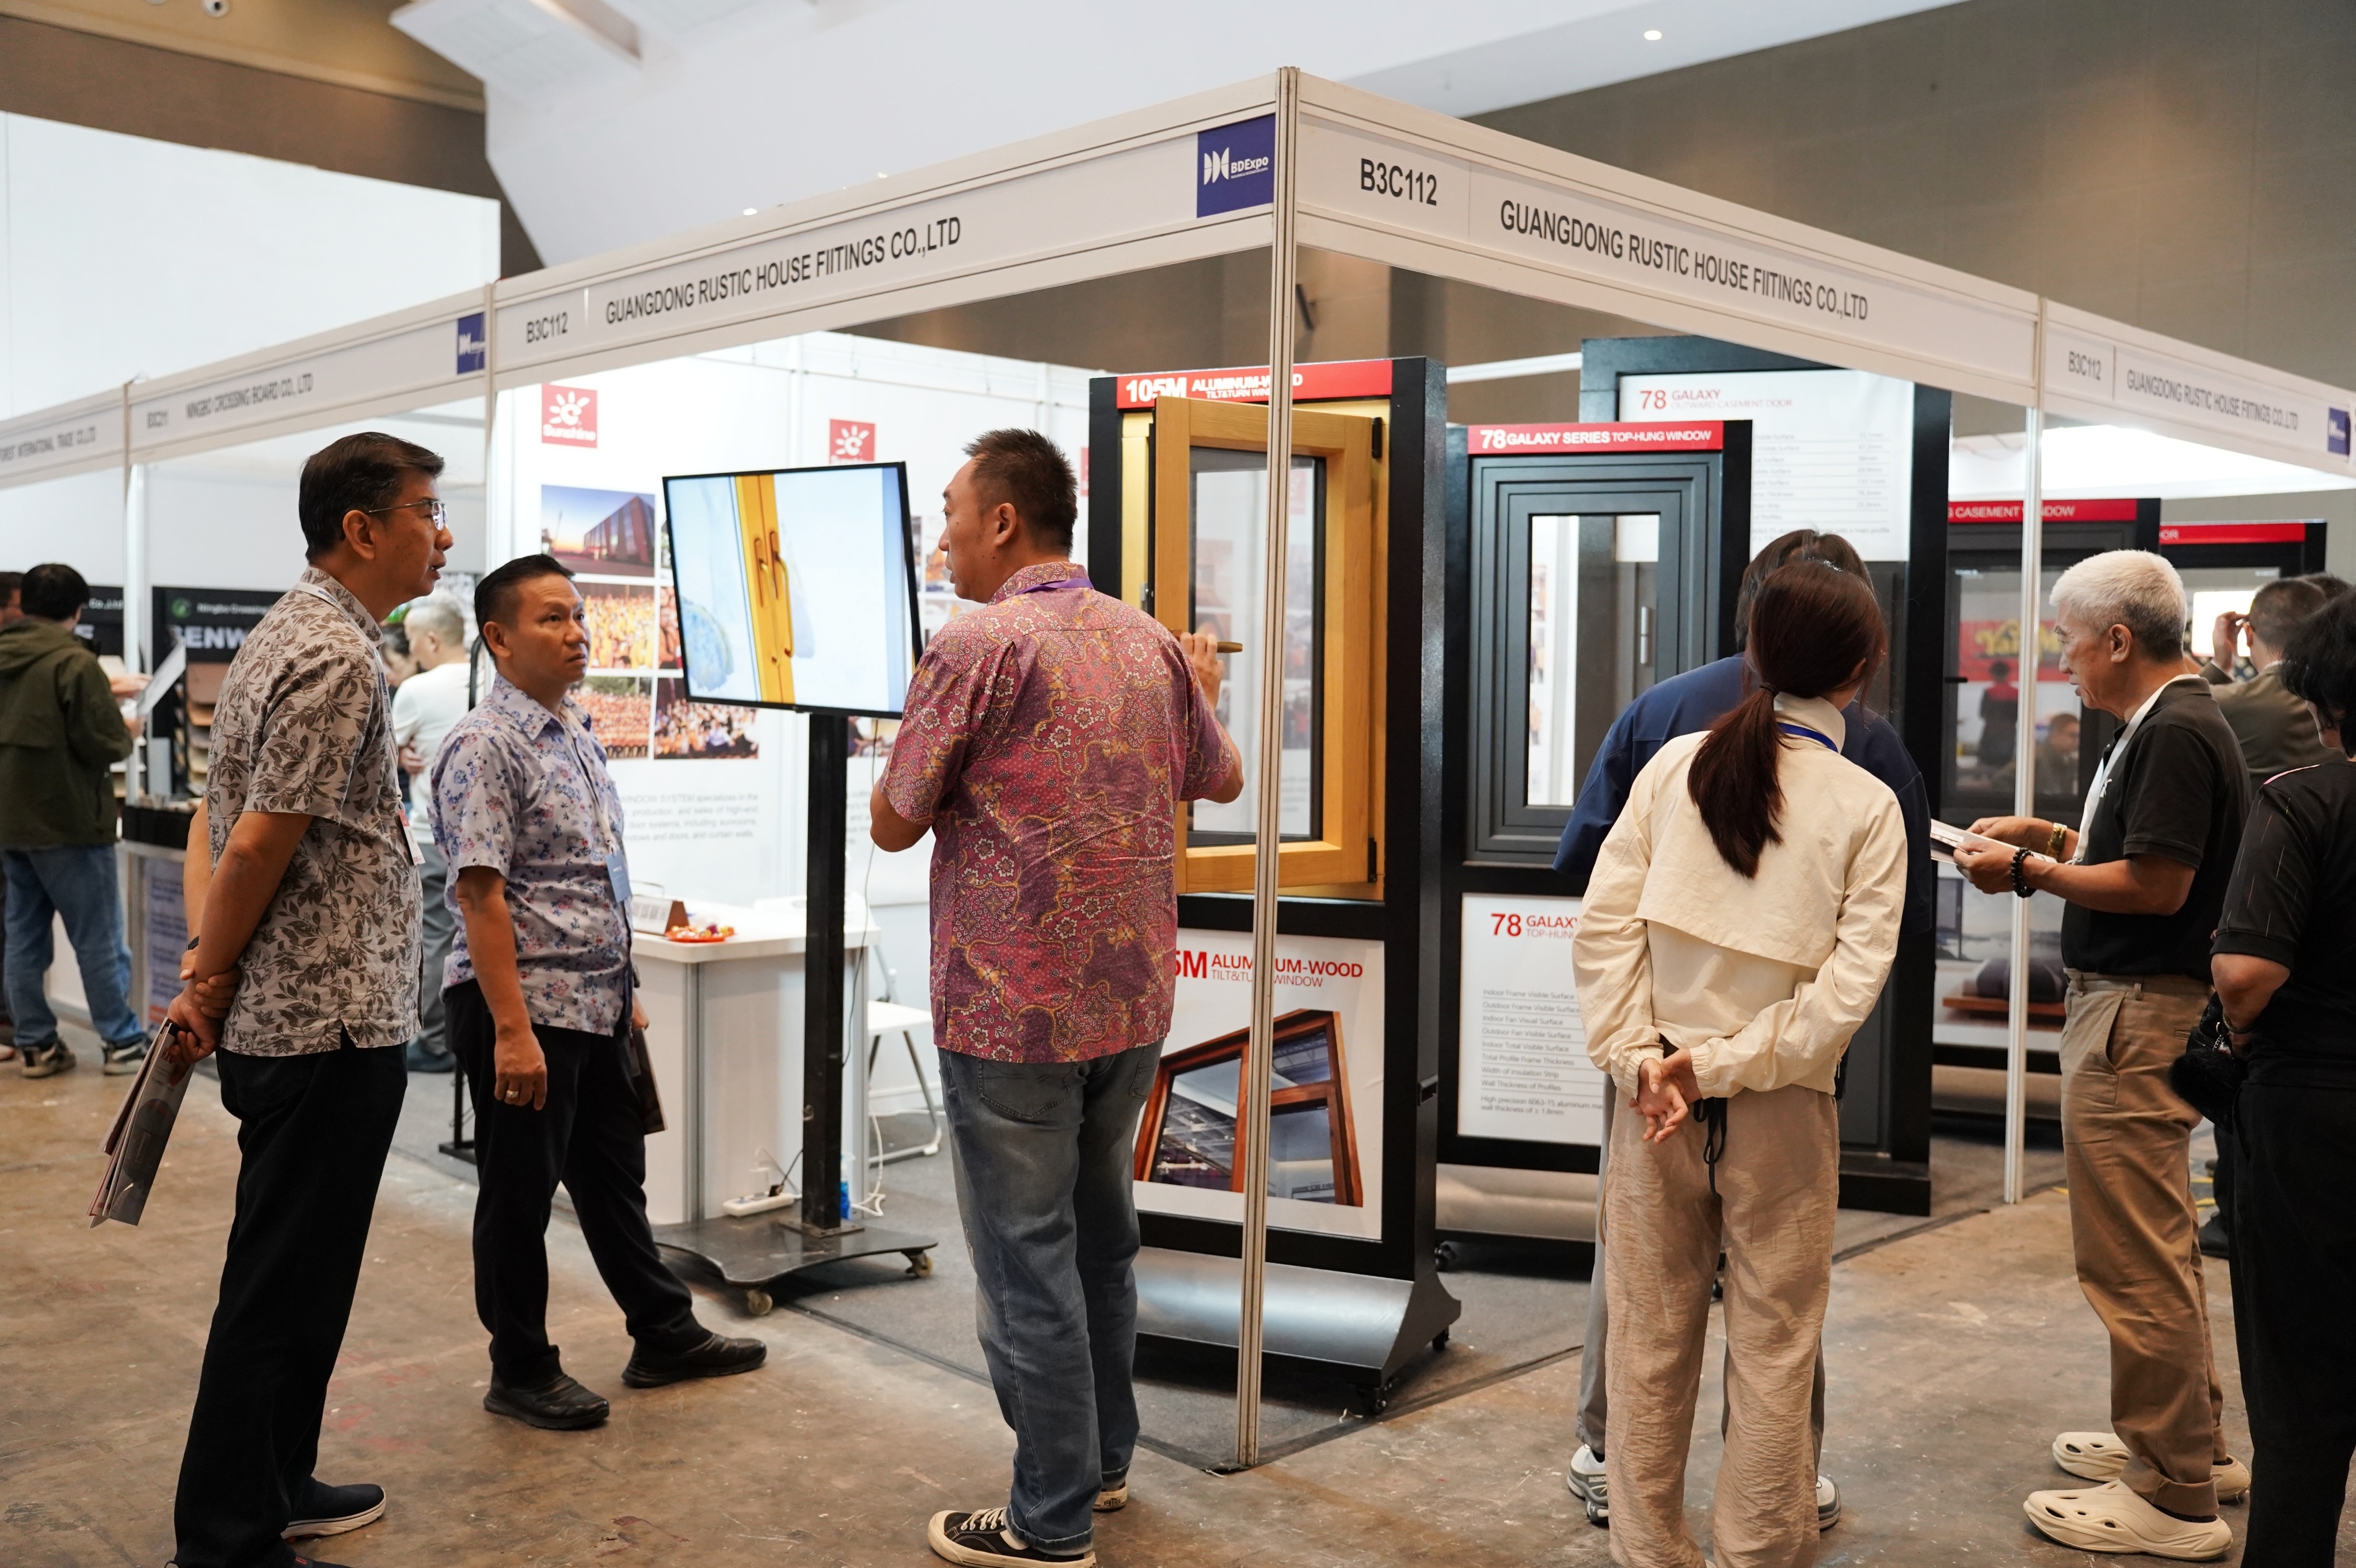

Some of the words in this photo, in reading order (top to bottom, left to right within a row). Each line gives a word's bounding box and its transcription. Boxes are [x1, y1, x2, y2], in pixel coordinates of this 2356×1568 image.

[1231, 156, 1269, 174] BDExpo
[1361, 158, 1437, 206] B3C112
[1501, 200, 1623, 258] GUANGDONG
[1629, 234, 1689, 275] RUSTIC
[1695, 251, 1748, 291] HOUSE
[1753, 267, 1812, 307] FIITINGS
[1817, 285, 1868, 321] CO.,LTD
[606, 281, 695, 325] GUANGDONG
[698, 269, 752, 302] RUSTIC
[756, 254, 812, 291] HOUSE
[816, 236, 885, 279] FIITINGS
[891, 216, 961, 260] CO.,LTD
[526, 311, 569, 344] B3C112
[2068, 350, 2102, 381] B3C112
[1126, 377, 1187, 402] 105M
[1206, 389, 1250, 399] TILT&TURN
[2127, 368, 2182, 402] GUANGDONG
[2184, 385, 2212, 410] RUSTIC
[2214, 393, 2240, 417] HOUSE
[1640, 390, 1666, 410] 78
[1672, 389, 1721, 401] GALAXY
[1765, 398, 1792, 407] DOOR
[1480, 429, 1507, 449] 78
[1507, 432, 1560, 446] GALAXY
[1562, 431, 1610, 444] SERIES
[1611, 431, 1665, 443] TOP-HUNG
[1665, 430, 1712, 442] WINDOW
[1955, 506, 2019, 519] CASEMENT
[1491, 912, 1521, 937] 78
[1506, 989, 1526, 997] Frame
[1550, 992, 1574, 1000] Surface
[1482, 1001, 1510, 1009] Outdoor
[1533, 1004, 1554, 1012] Visible
[1556, 1005, 1581, 1013] Surface
[1539, 1017, 1563, 1026] Surface
[1482, 1027, 1509, 1036] Outdoor
[1524, 1029, 1546, 1037] Visible
[1547, 1031, 1571, 1040] Surface
[1523, 1042, 1543, 1051] Visible
[1545, 1044, 1569, 1052] Surface
[1499, 1054, 1519, 1062] Profile
[1544, 1057, 1574, 1065] Thickness
[1482, 1066, 1501, 1074] Width
[1544, 1070, 1559, 1079] Strip
[1498, 1080, 1527, 1089] Thickness
[1537, 1083, 1561, 1091] Profiles
[1481, 1095, 1496, 1103] High
[1498, 1097, 1527, 1105] precision
[1556, 1099, 1589, 1109] aluminum
[1495, 1105, 1524, 1113] thickness
